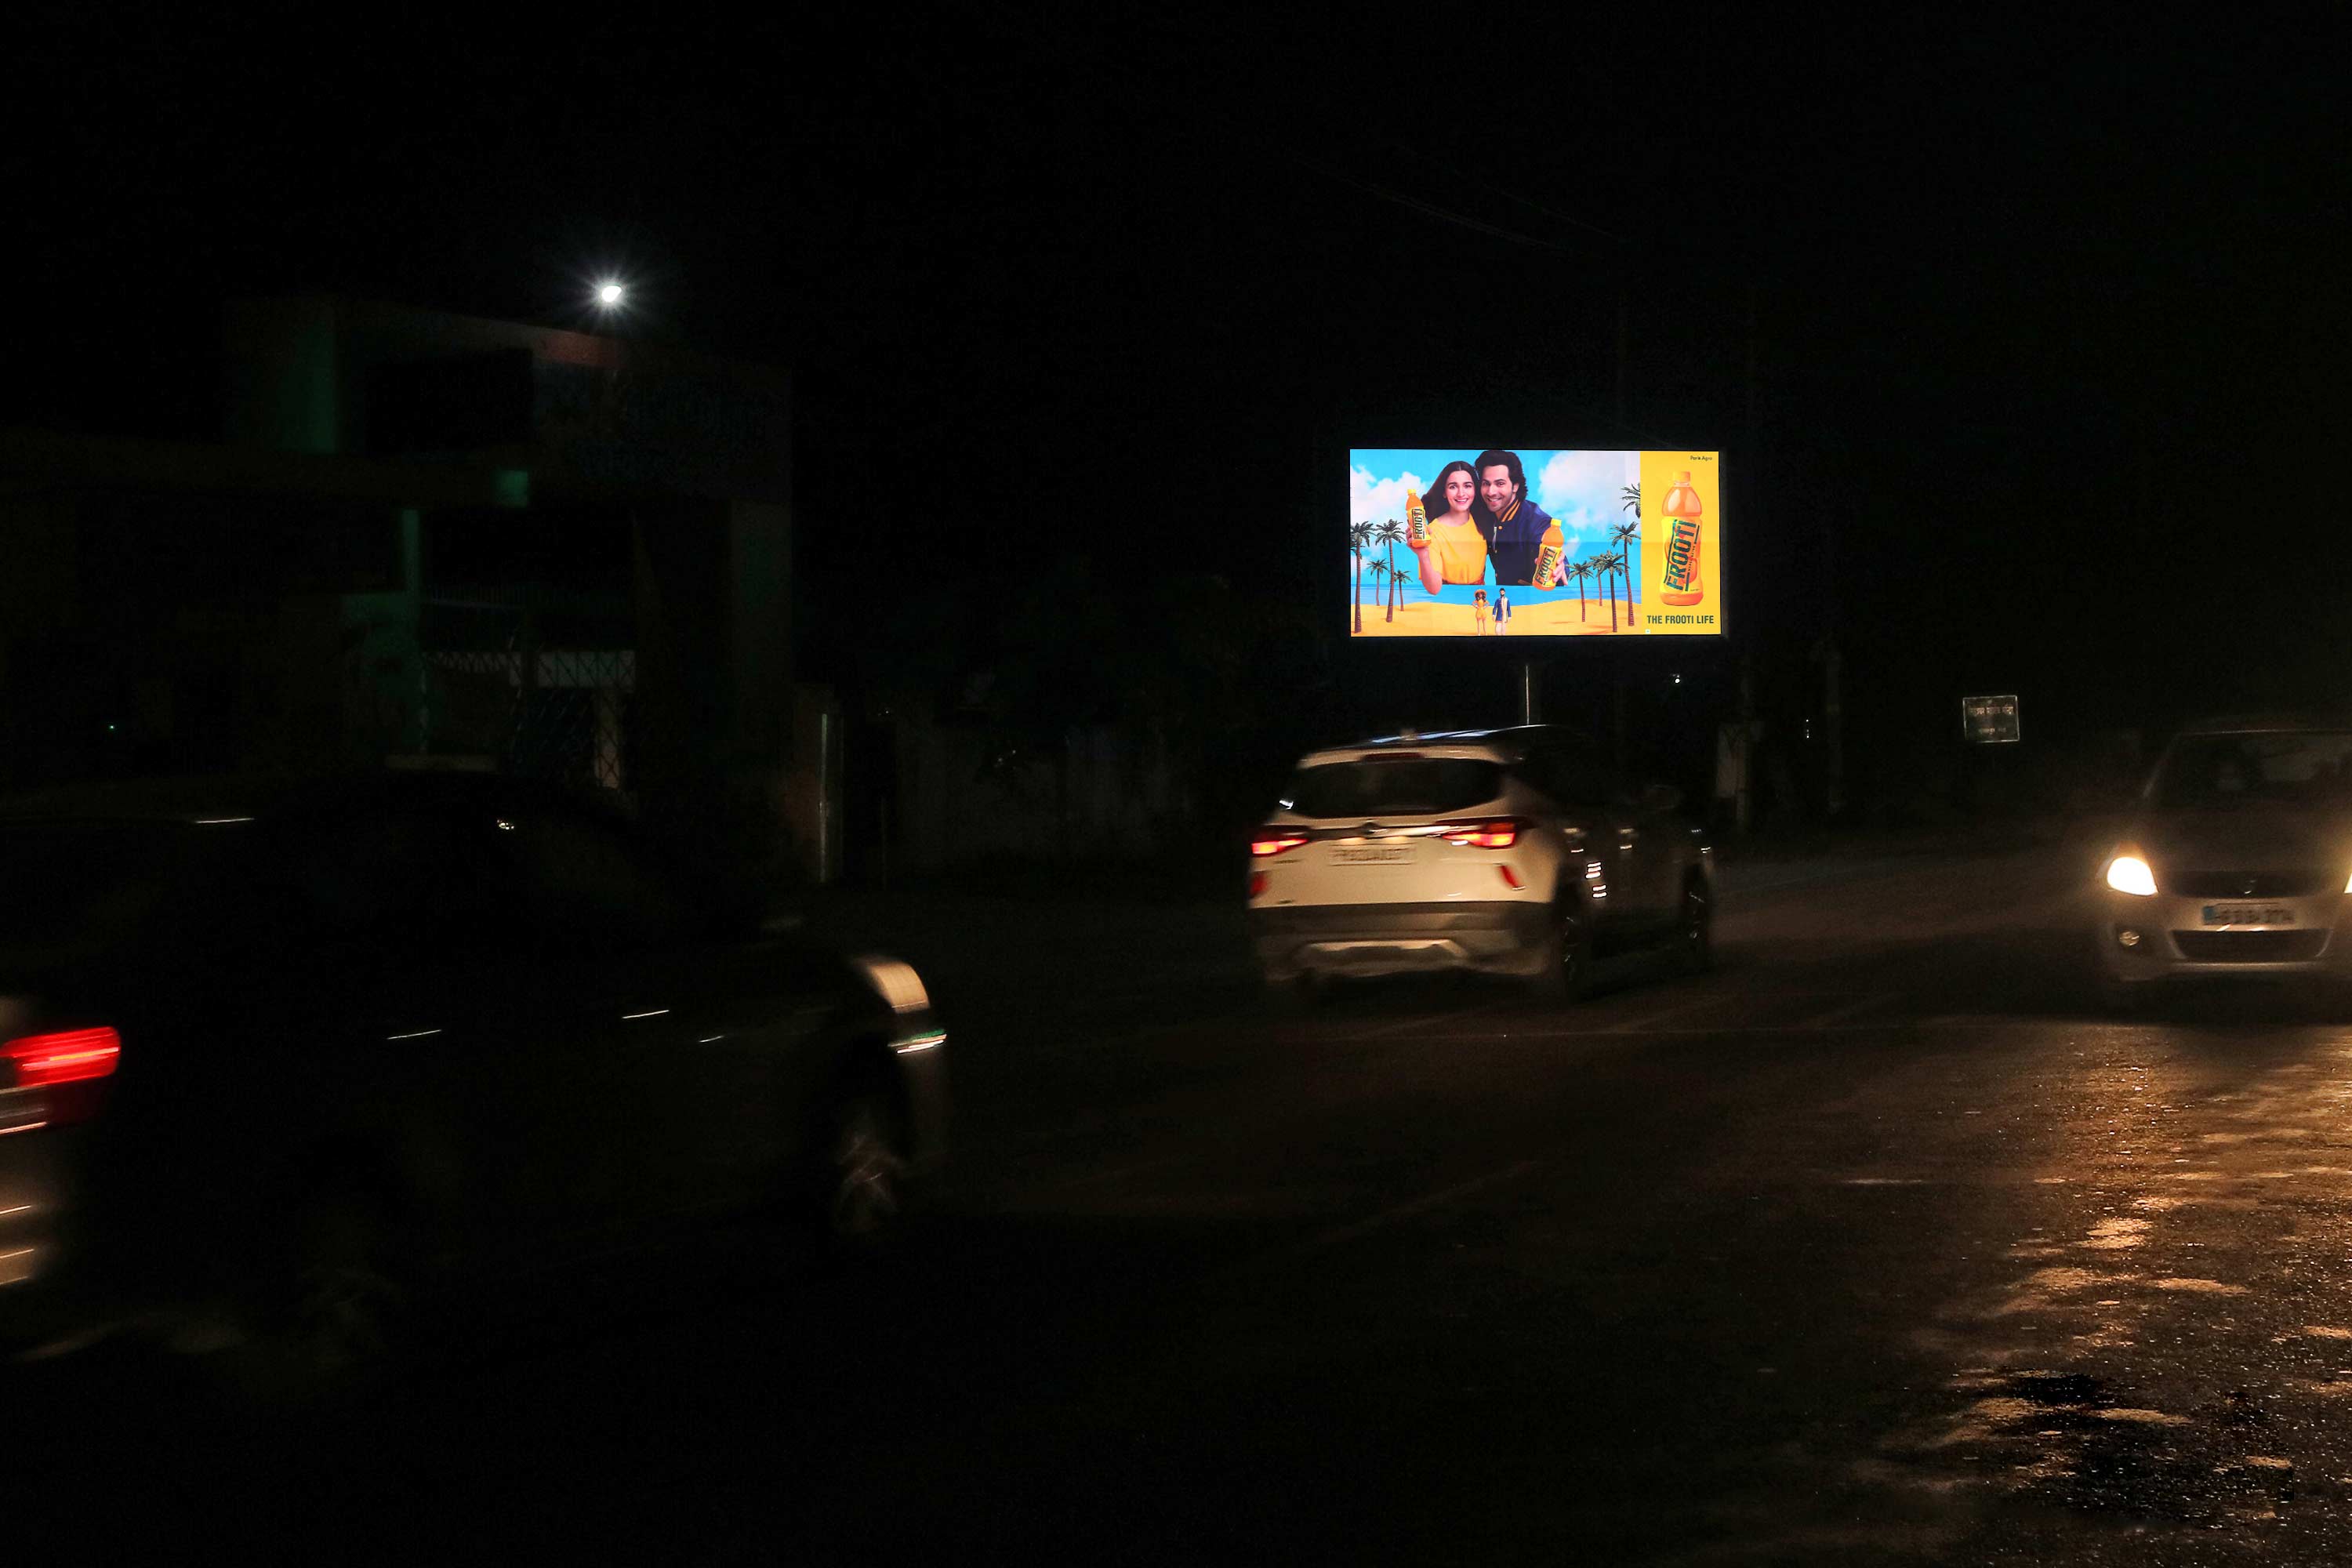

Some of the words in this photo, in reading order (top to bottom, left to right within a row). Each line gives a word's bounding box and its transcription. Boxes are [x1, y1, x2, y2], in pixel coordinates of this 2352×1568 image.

[1414, 508, 1423, 539] FROOTI
[1535, 548, 1555, 585] FROOTI
[1666, 520, 1697, 590] FROOTI
[1646, 615, 1663, 624] THE
[1665, 615, 1694, 624] FROOTI
[1697, 615, 1715, 624] LIFE
